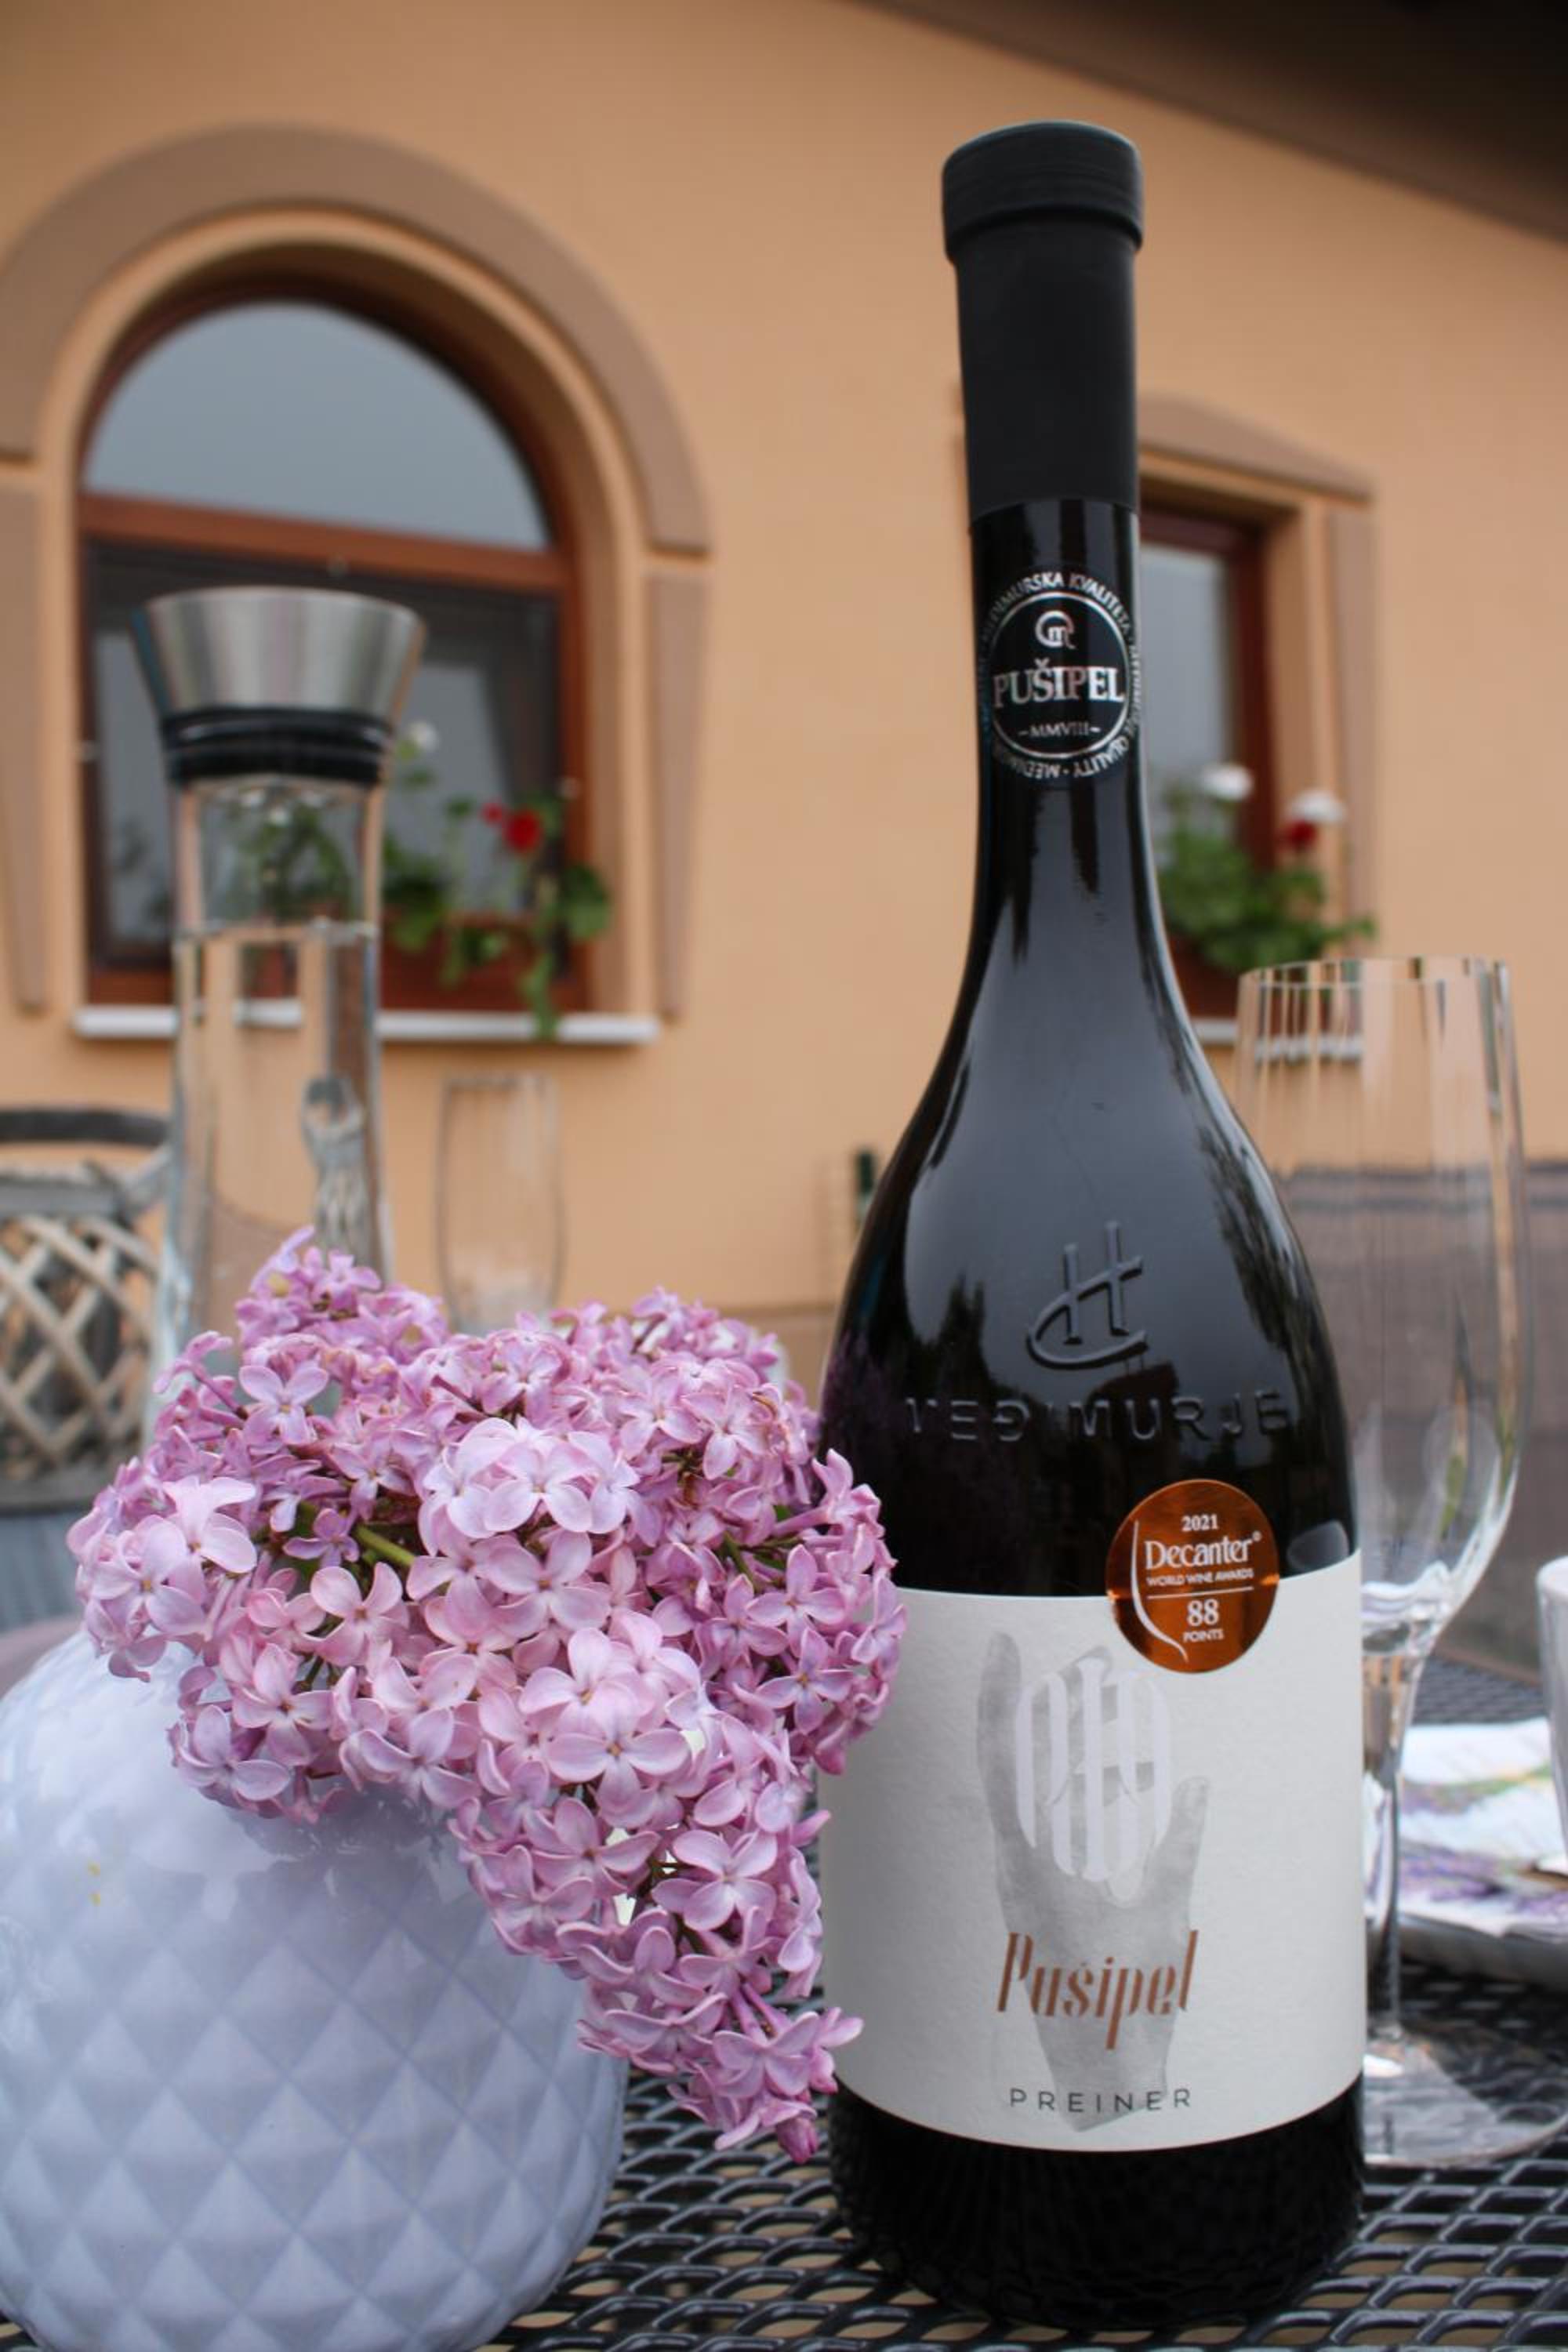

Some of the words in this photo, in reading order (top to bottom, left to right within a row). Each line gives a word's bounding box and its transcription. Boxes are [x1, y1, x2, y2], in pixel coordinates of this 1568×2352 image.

[993, 657, 1127, 707] PUŠIPEL
[1181, 1513, 1219, 1532] 2021
[1144, 1535, 1254, 1570] Decanter
[1145, 1574, 1185, 1587] WORLD
[1185, 1570, 1214, 1584] WINE
[1215, 1567, 1254, 1582] AWARDS
[1187, 1598, 1219, 1627] 88
[1182, 1628, 1225, 1643] POINTS
[1009, 2086, 1192, 2114] PREINER
